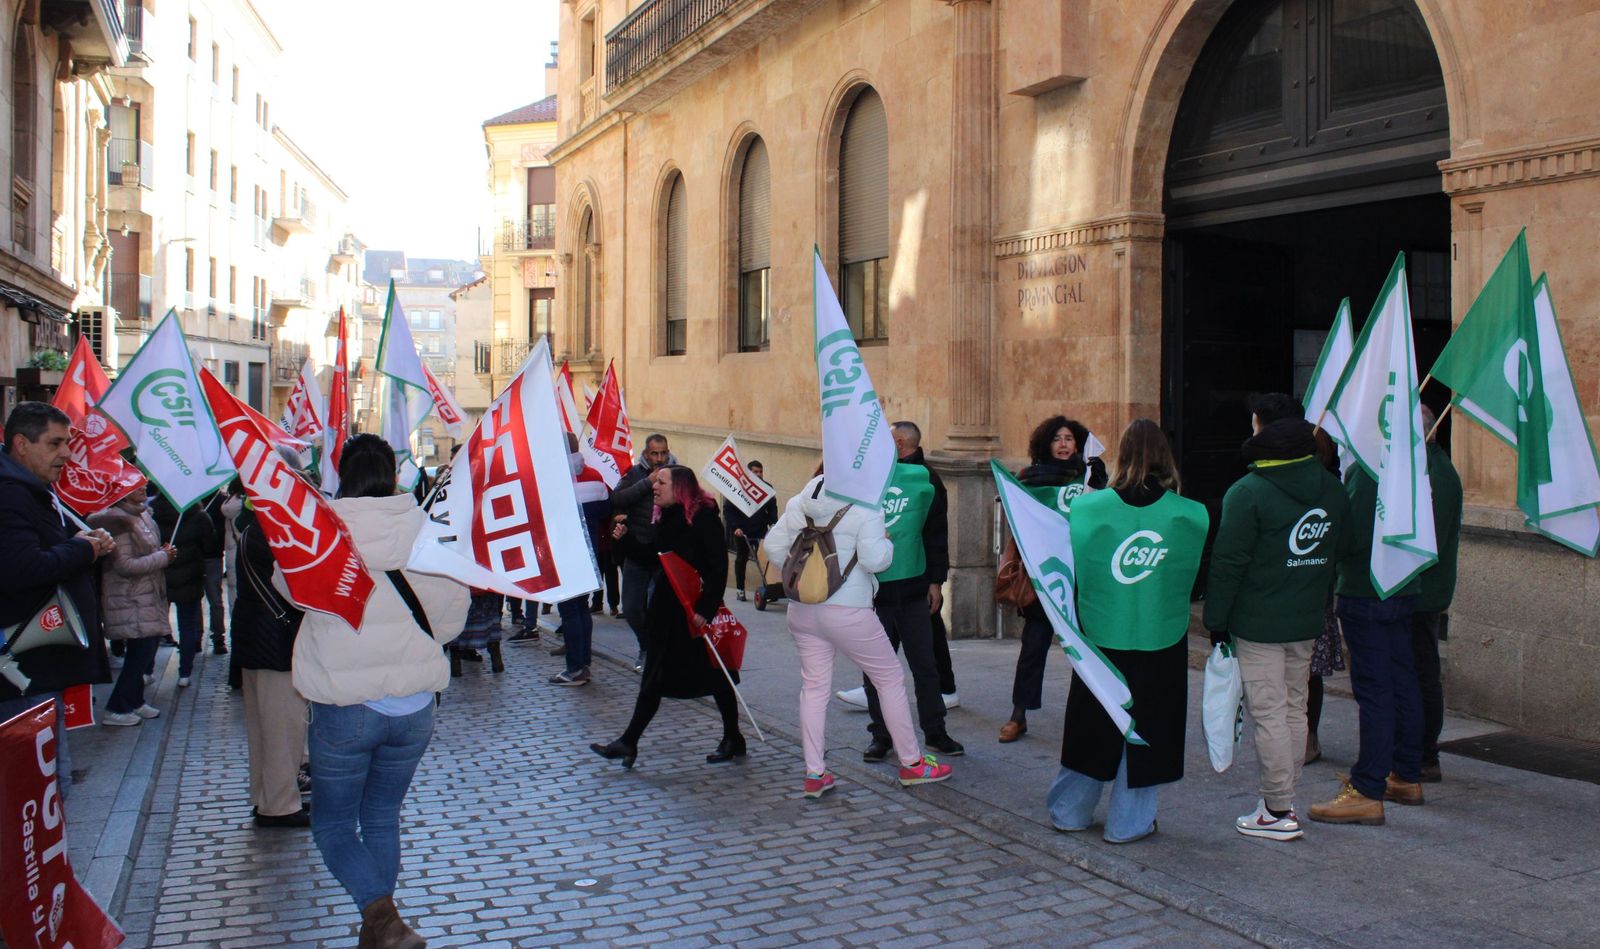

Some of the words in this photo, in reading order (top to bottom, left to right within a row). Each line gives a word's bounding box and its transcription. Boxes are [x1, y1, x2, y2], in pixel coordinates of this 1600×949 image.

[148, 427, 193, 476] Salamanca
[710, 467, 733, 488] Castilla
[1297, 521, 1332, 540] CSIF
[1122, 546, 1168, 567] CSIF
[22, 799, 40, 902] Castilla
